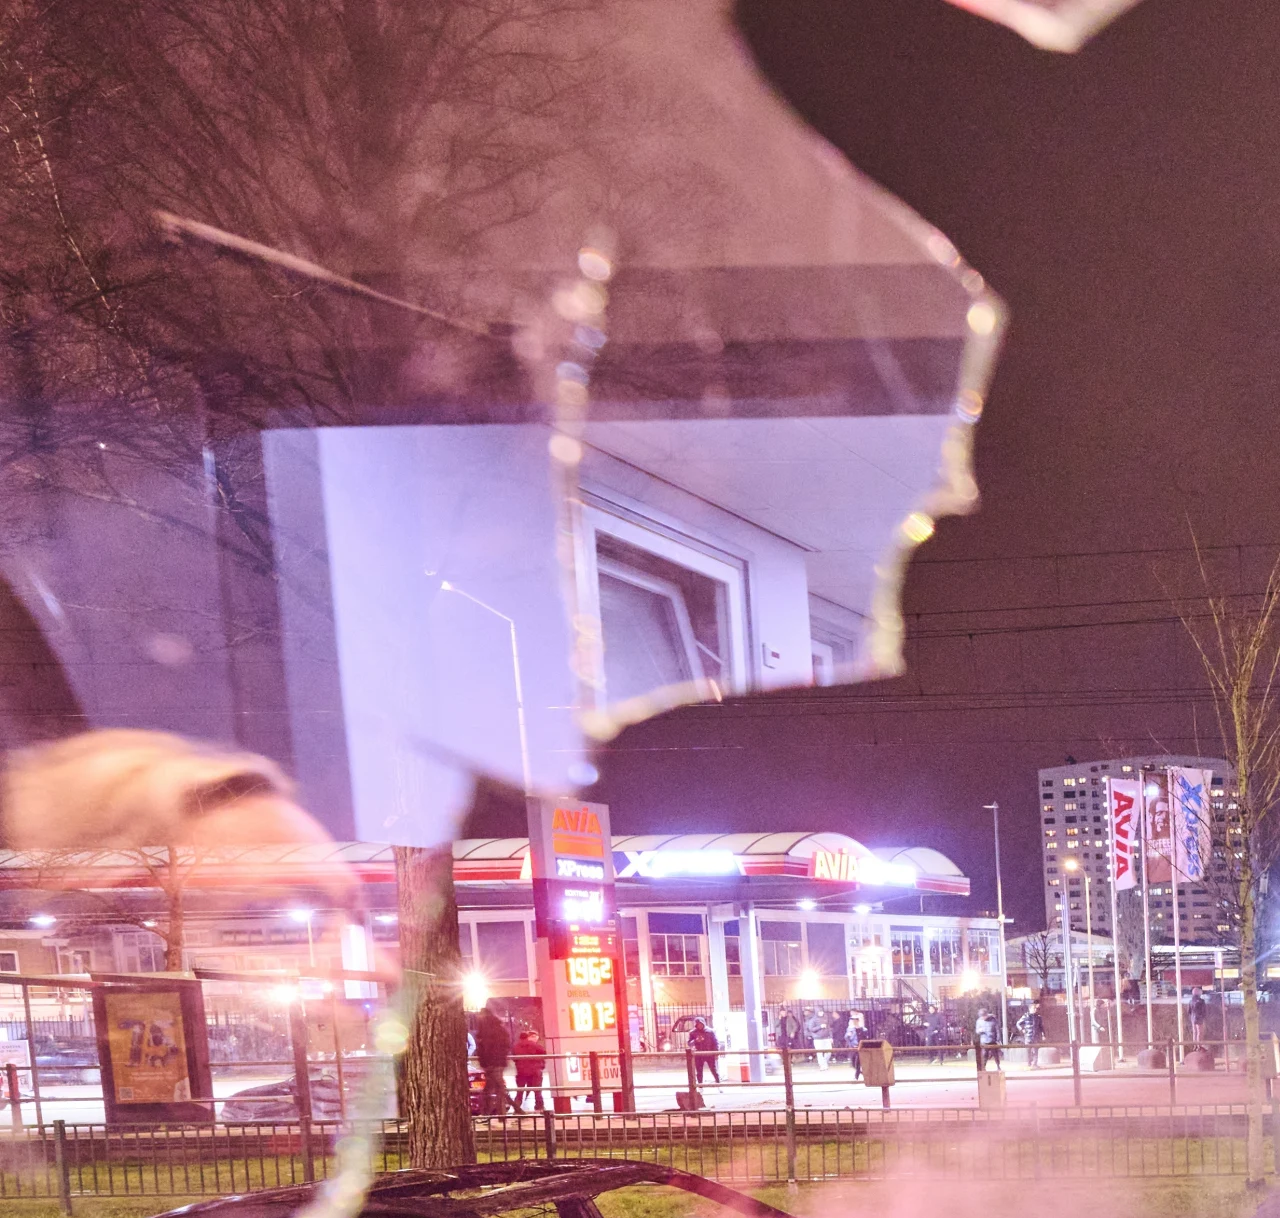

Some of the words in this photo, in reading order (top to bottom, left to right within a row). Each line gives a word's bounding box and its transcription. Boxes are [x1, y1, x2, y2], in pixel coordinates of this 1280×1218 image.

[552, 807, 602, 834] AVIA
[1113, 790, 1134, 880] AVIA
[567, 990, 590, 998] DIESEL
